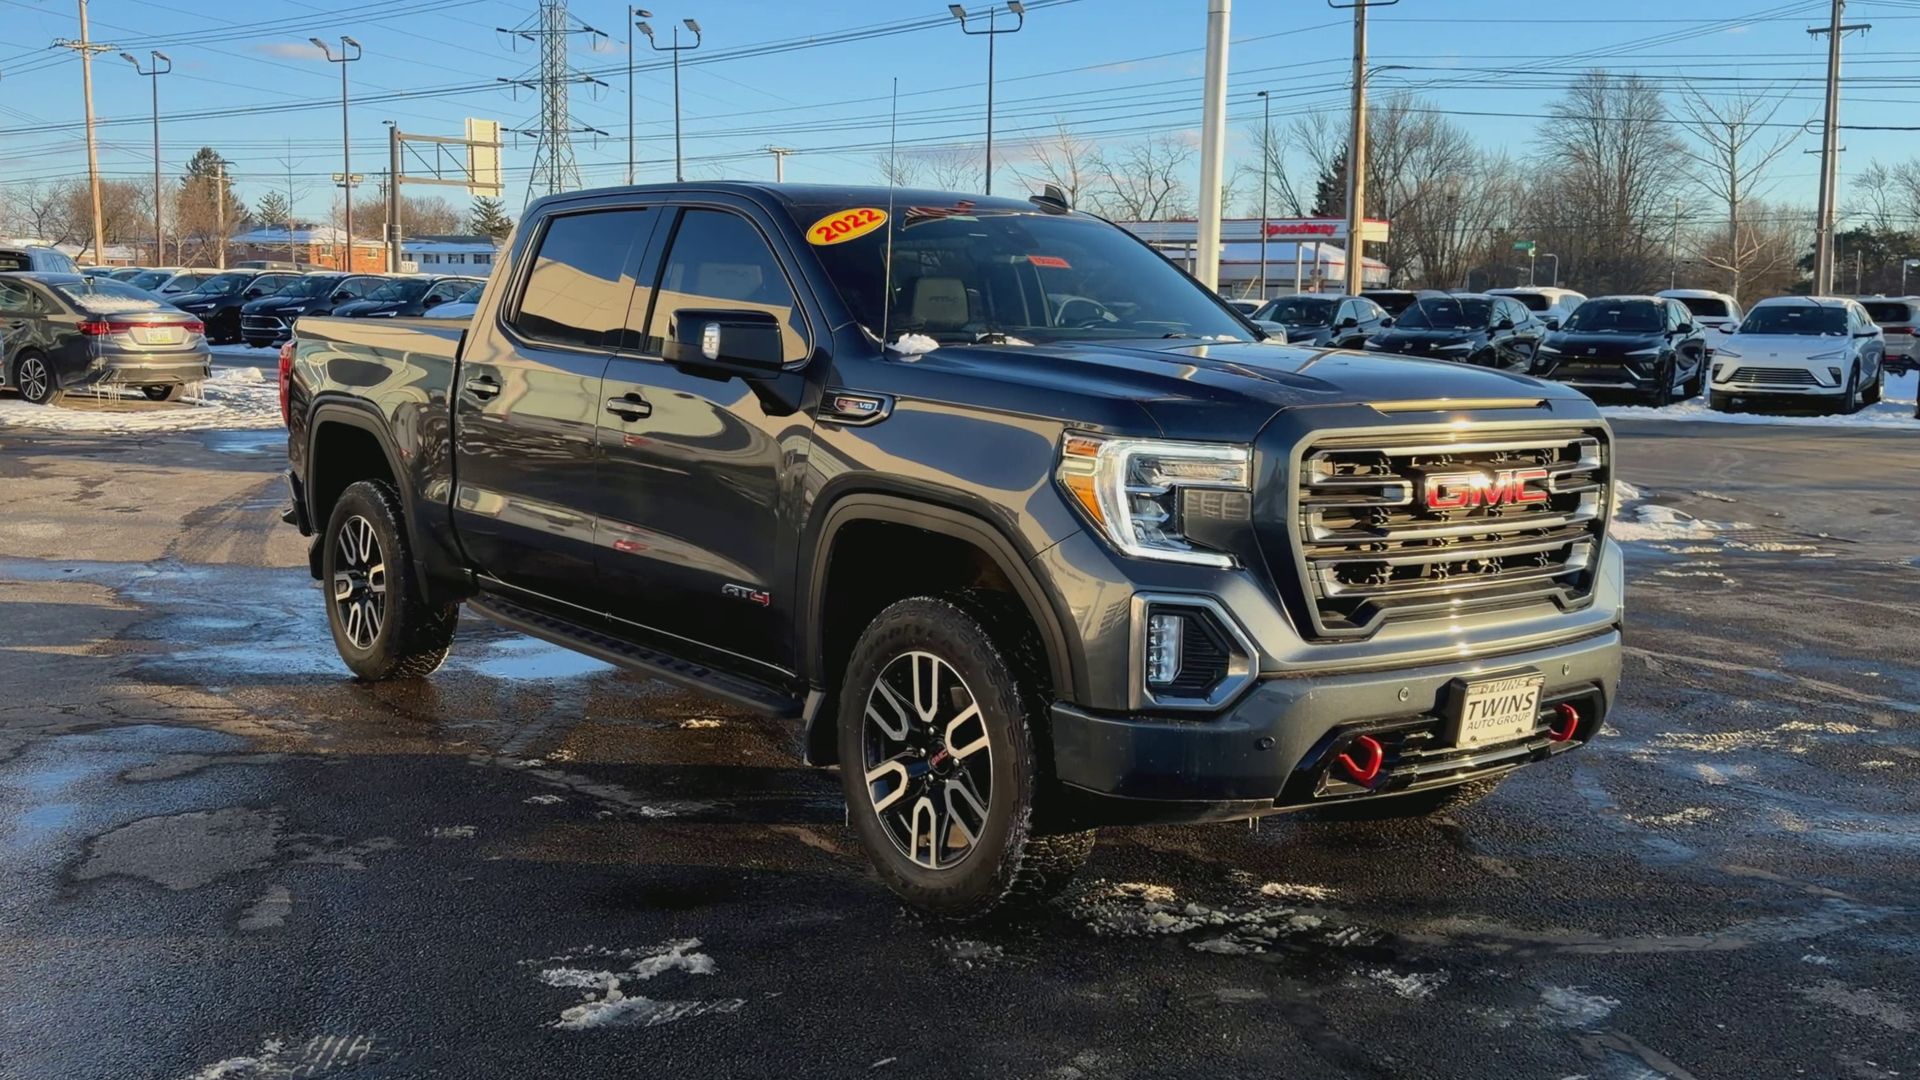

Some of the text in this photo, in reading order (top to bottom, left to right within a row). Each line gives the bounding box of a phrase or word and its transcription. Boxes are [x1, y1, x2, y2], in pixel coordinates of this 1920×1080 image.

[816, 209, 880, 241] 2022
[1425, 469, 1548, 509] GMC
[721, 583, 770, 607] AT4
[1468, 691, 1535, 720] TWINS
[1467, 711, 1531, 731] AUTO GROUP
